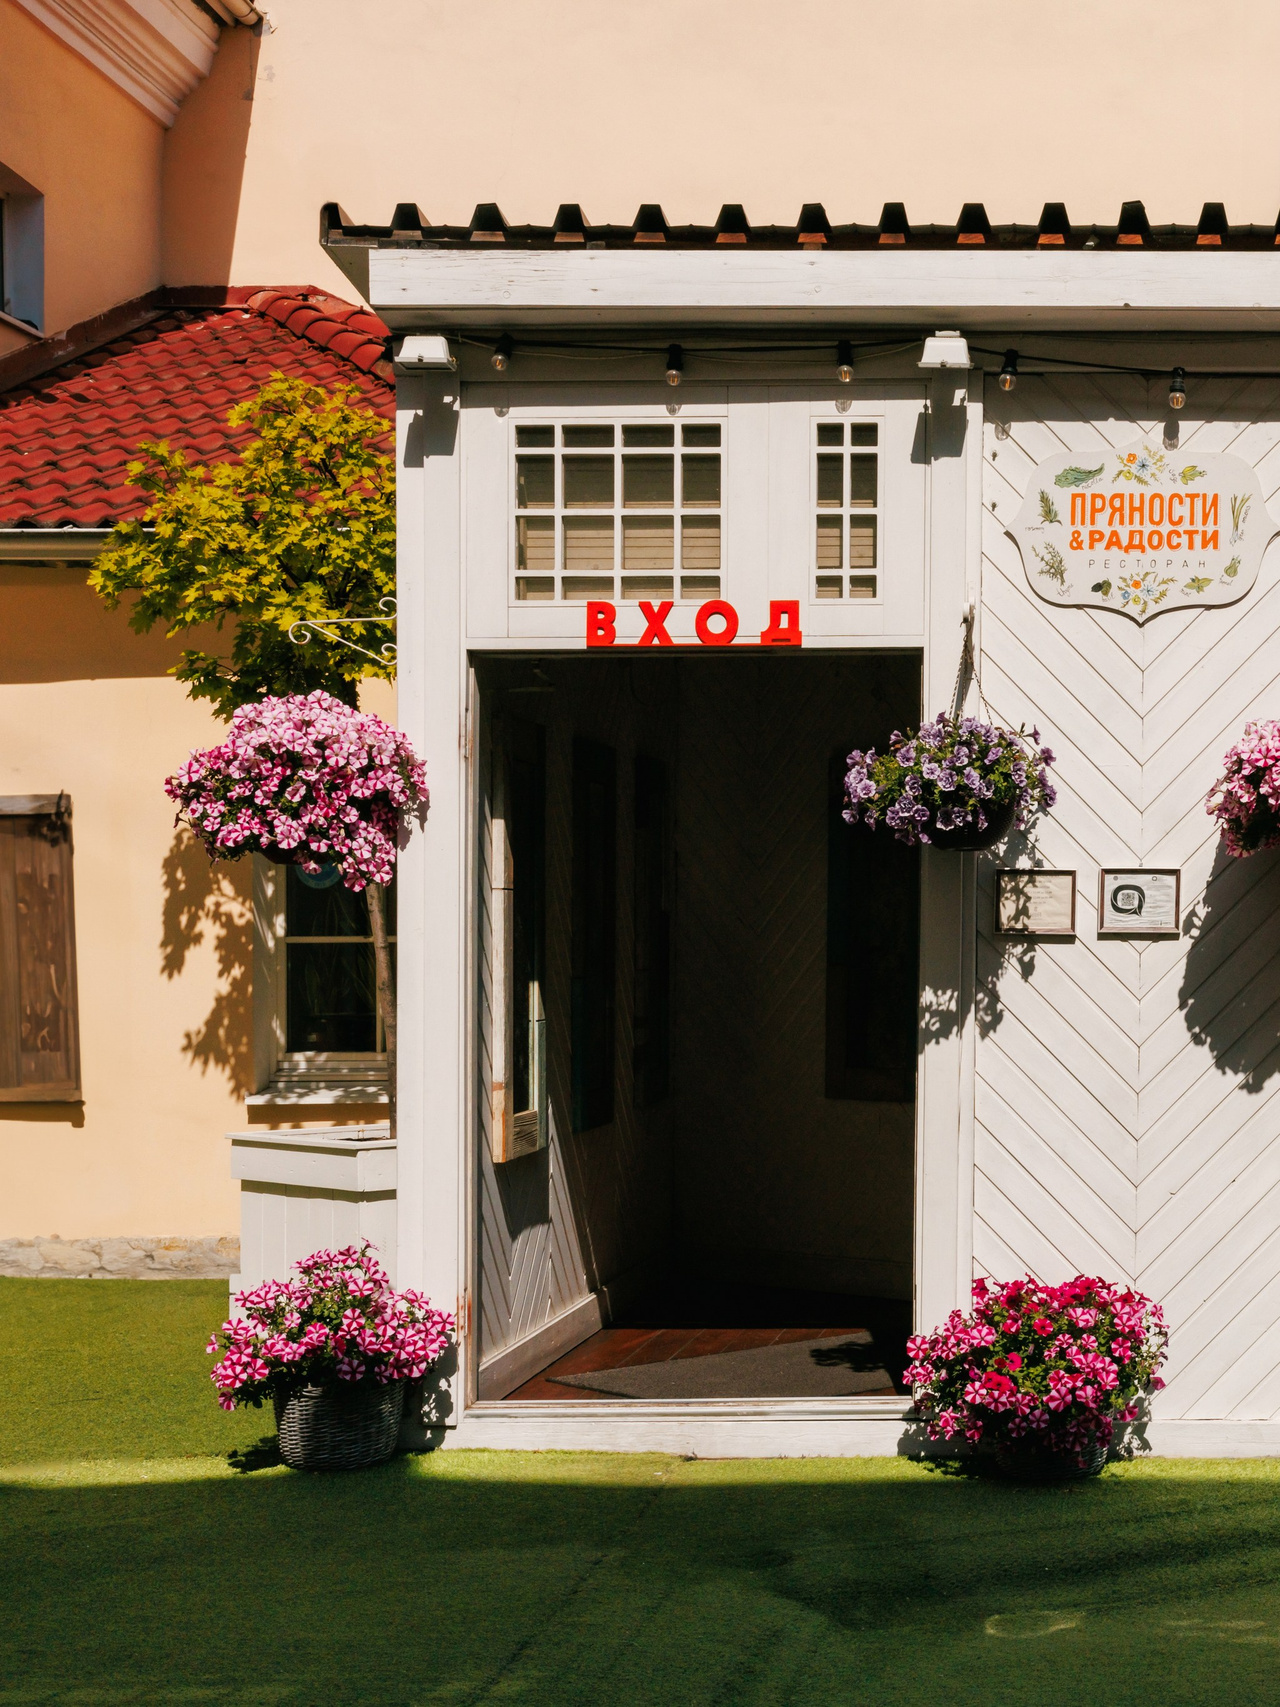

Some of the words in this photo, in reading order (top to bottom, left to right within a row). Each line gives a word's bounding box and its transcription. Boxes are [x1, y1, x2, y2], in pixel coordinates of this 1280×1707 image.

[1070, 492, 1219, 527] ПРЯНОСТИ
[1088, 559, 1206, 569] РЕСТОРАН
[587, 600, 802, 646] ВХОД
